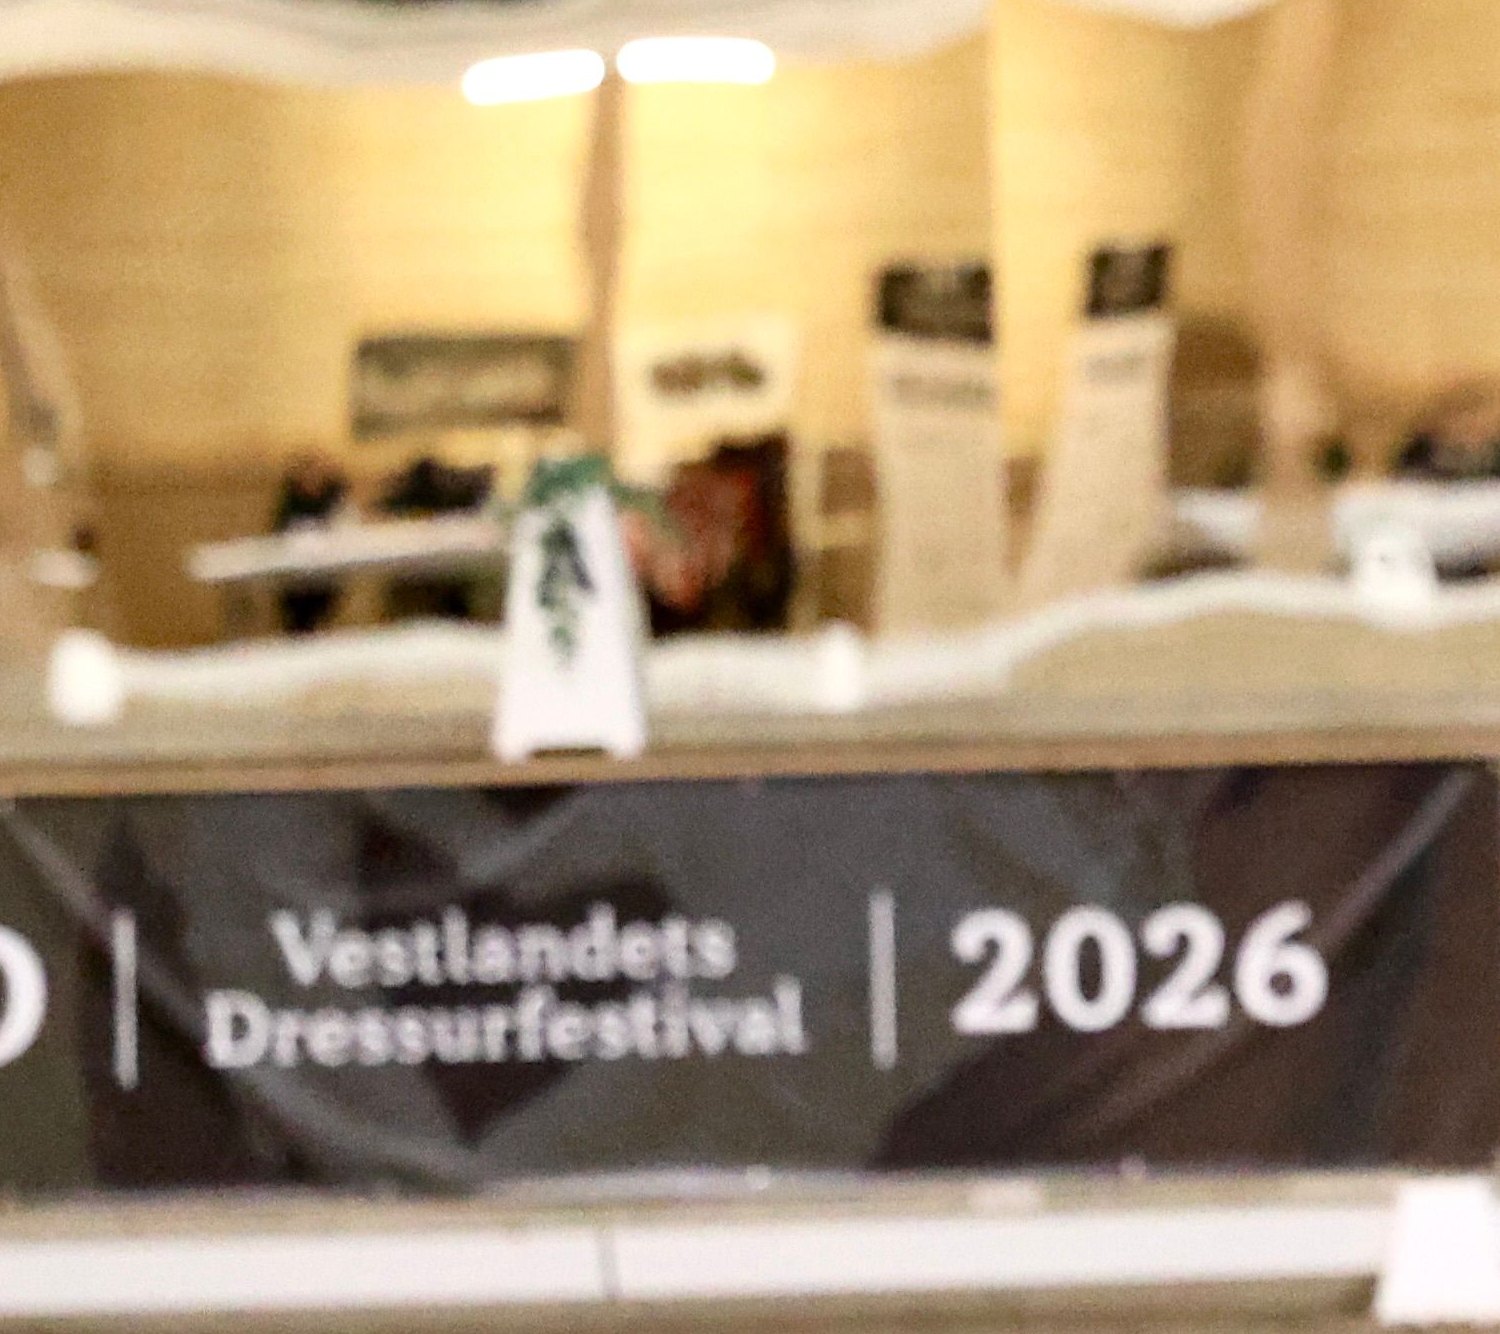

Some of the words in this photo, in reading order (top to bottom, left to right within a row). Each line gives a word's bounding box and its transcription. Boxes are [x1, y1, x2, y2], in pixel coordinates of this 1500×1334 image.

[269, 903, 738, 987] Vestlandets
[950, 903, 1328, 1035] 2026
[204, 978, 806, 1070] Dressurfestival
